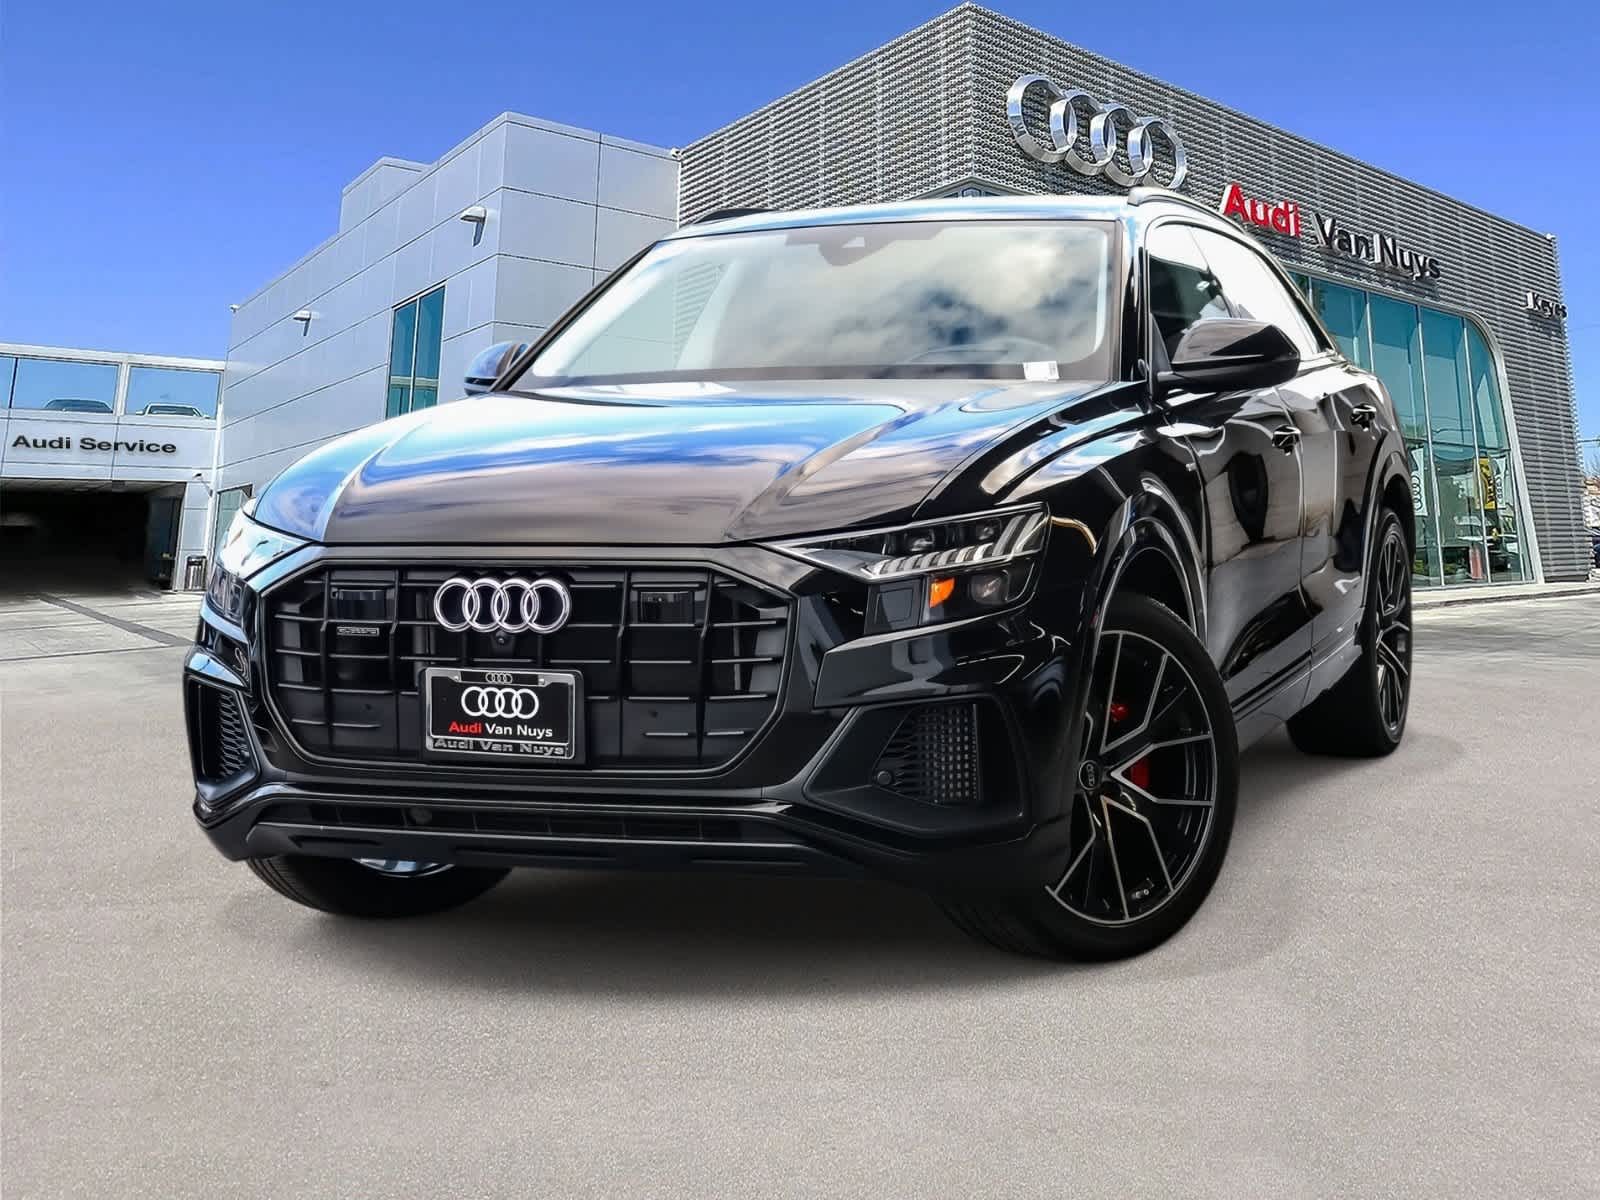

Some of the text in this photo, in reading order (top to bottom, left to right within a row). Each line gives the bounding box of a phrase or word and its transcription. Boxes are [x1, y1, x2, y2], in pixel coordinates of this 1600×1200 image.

[1221, 183, 1441, 280] Audi Van Nuys
[12, 435, 177, 453] Audi Service
[449, 721, 553, 739] Audi Van Nuys
[434, 738, 564, 756] Audi Van Nuys
